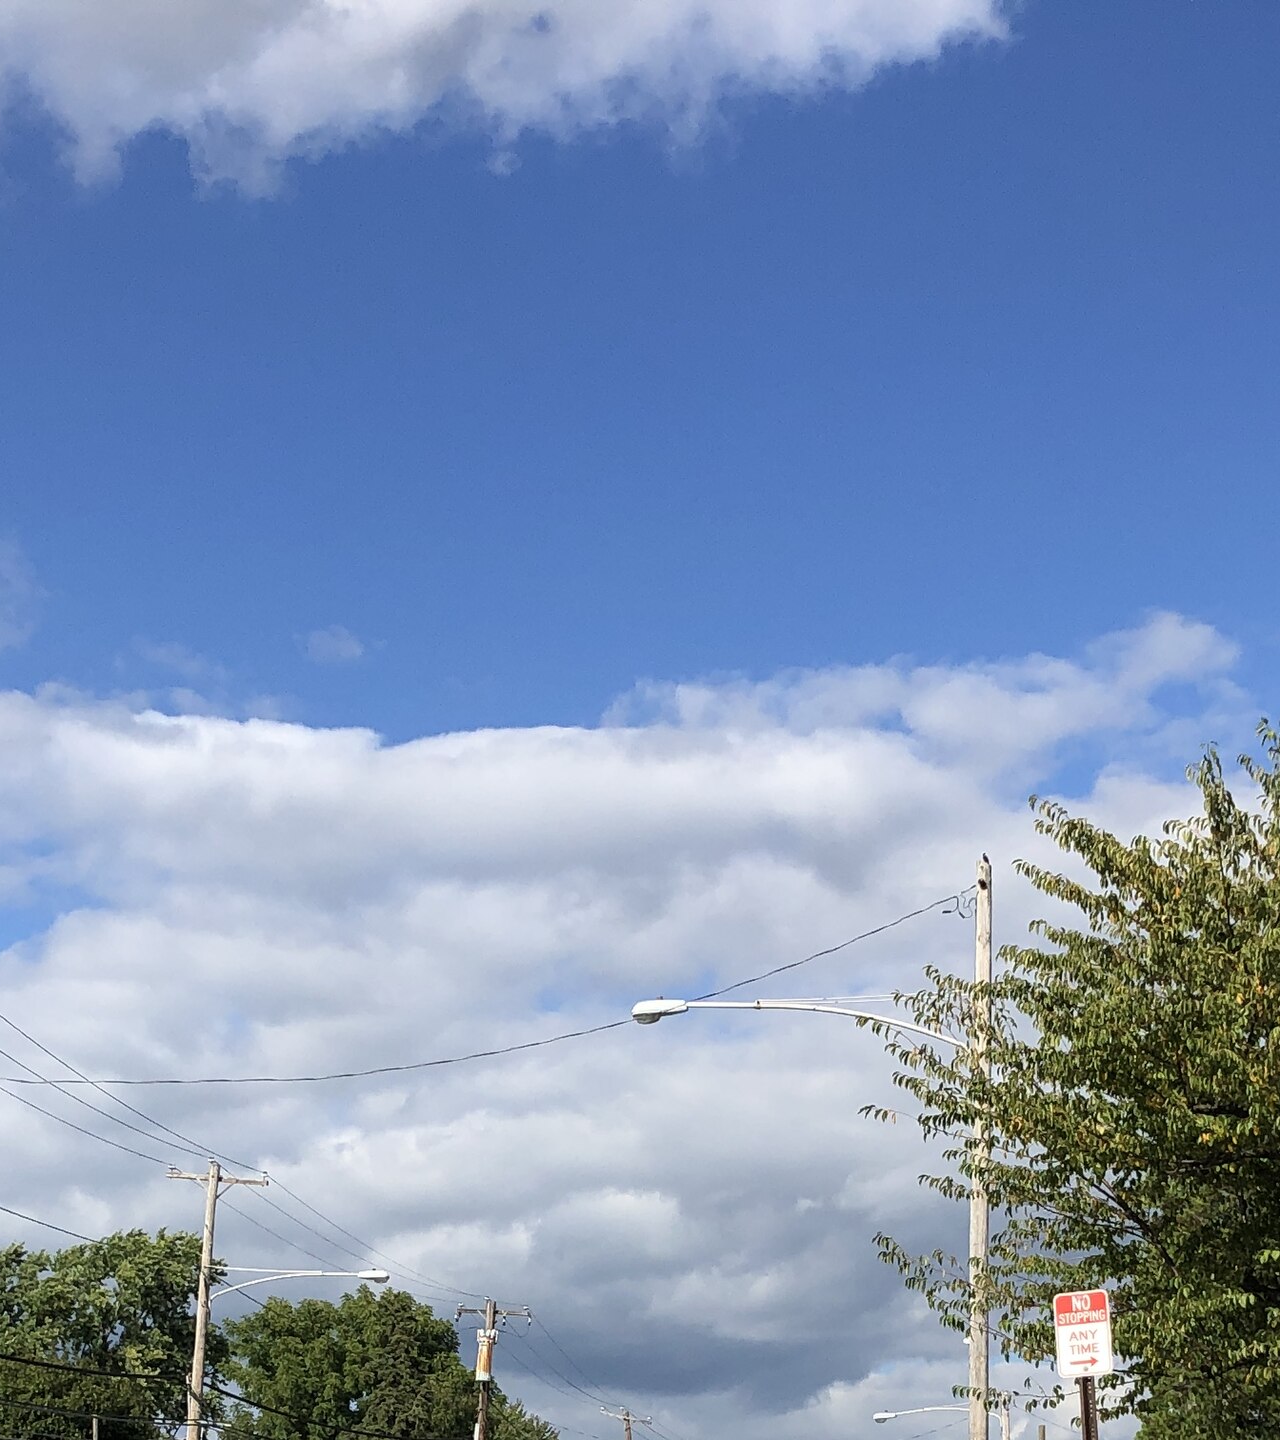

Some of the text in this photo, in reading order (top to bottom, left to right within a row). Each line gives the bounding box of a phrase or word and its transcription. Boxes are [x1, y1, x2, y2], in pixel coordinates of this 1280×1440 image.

[1071, 1294, 1091, 1312] NO
[1058, 1309, 1106, 1325] STOPPING
[1069, 1329, 1098, 1342] ANY
[1069, 1342, 1100, 1355] TIME
